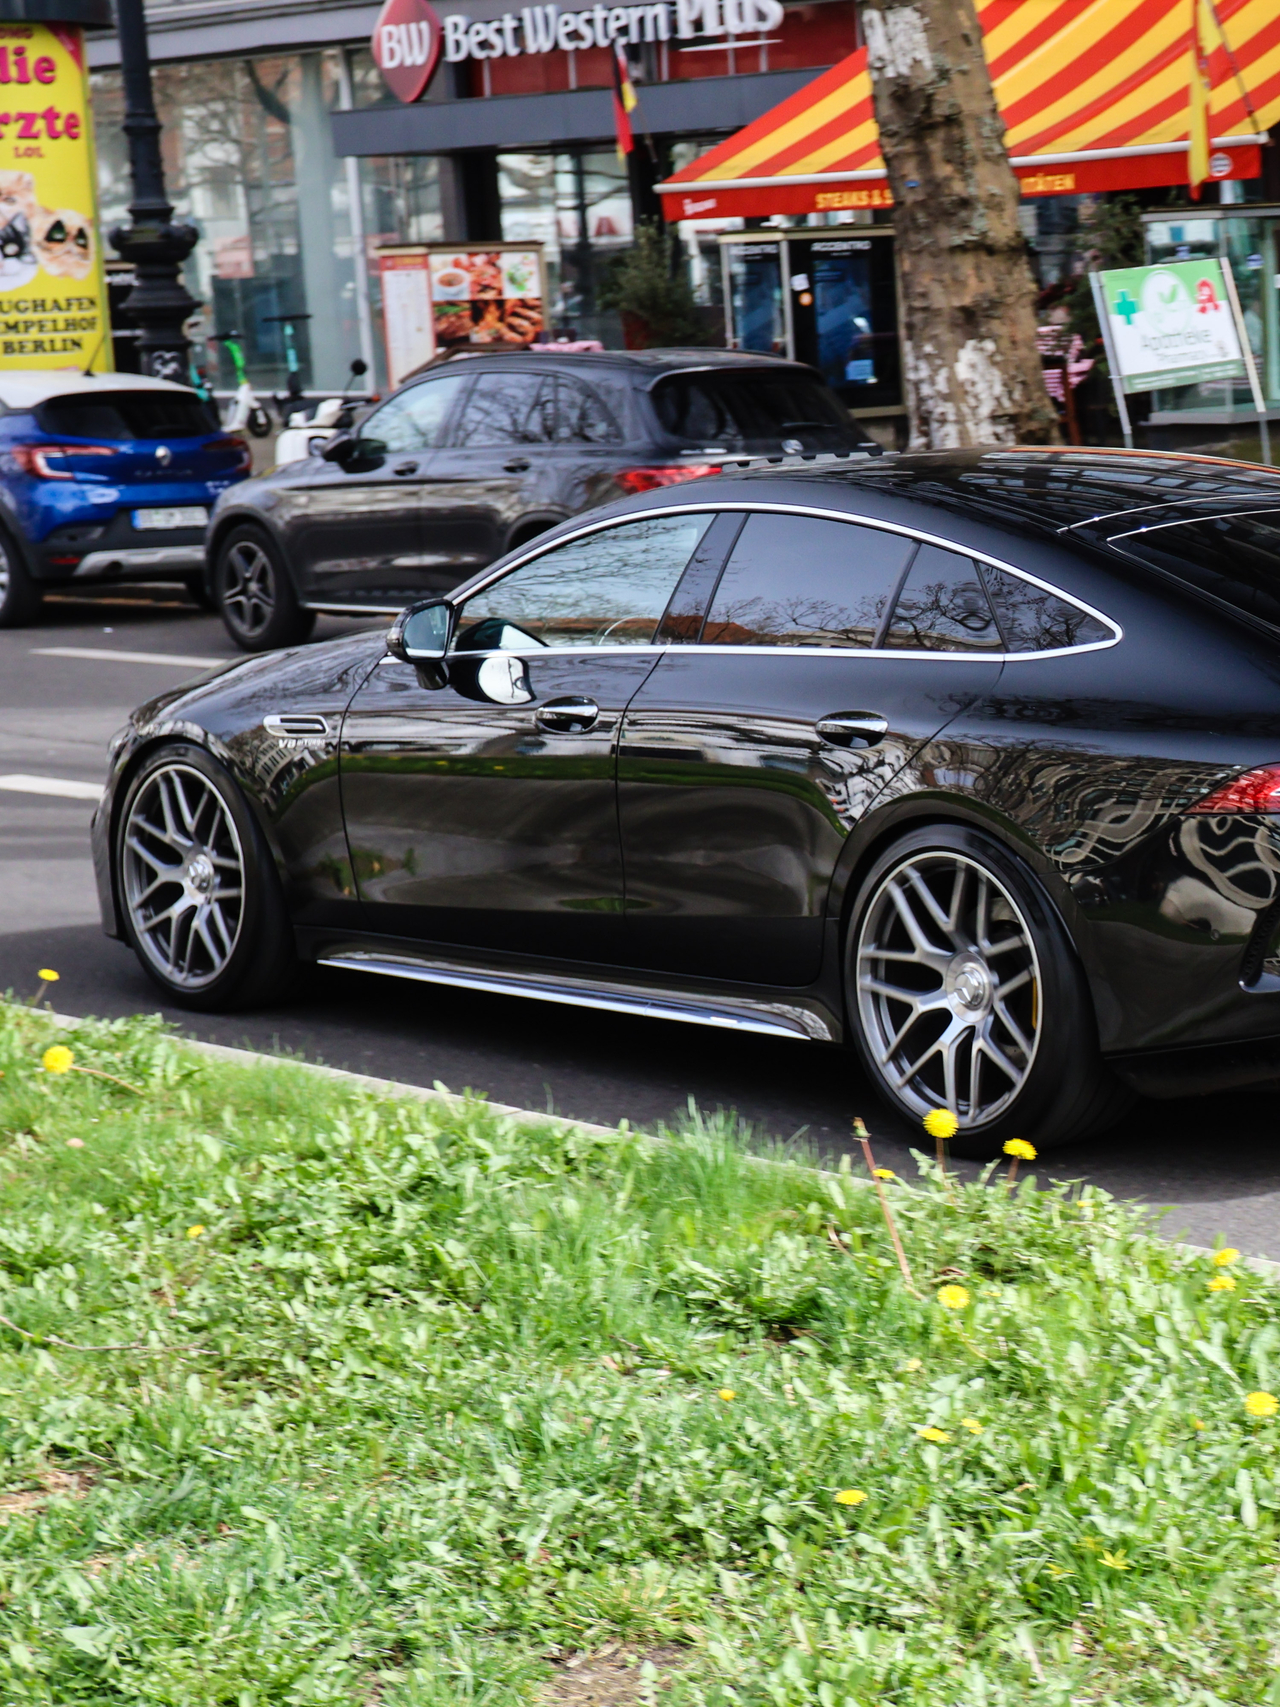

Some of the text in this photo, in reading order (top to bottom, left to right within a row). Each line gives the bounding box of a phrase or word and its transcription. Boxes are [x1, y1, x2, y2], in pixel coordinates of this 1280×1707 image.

[444, 14, 522, 63] Best
[522, 2, 670, 54] Western
[381, 21, 430, 69] BW
[14, 146, 45, 159] LOL
[815, 190, 868, 209] STEAKS
[811, 240, 871, 251] ACCENTRO
[3, 337, 83, 354] BERLIN
[278, 739, 297, 749] V8
